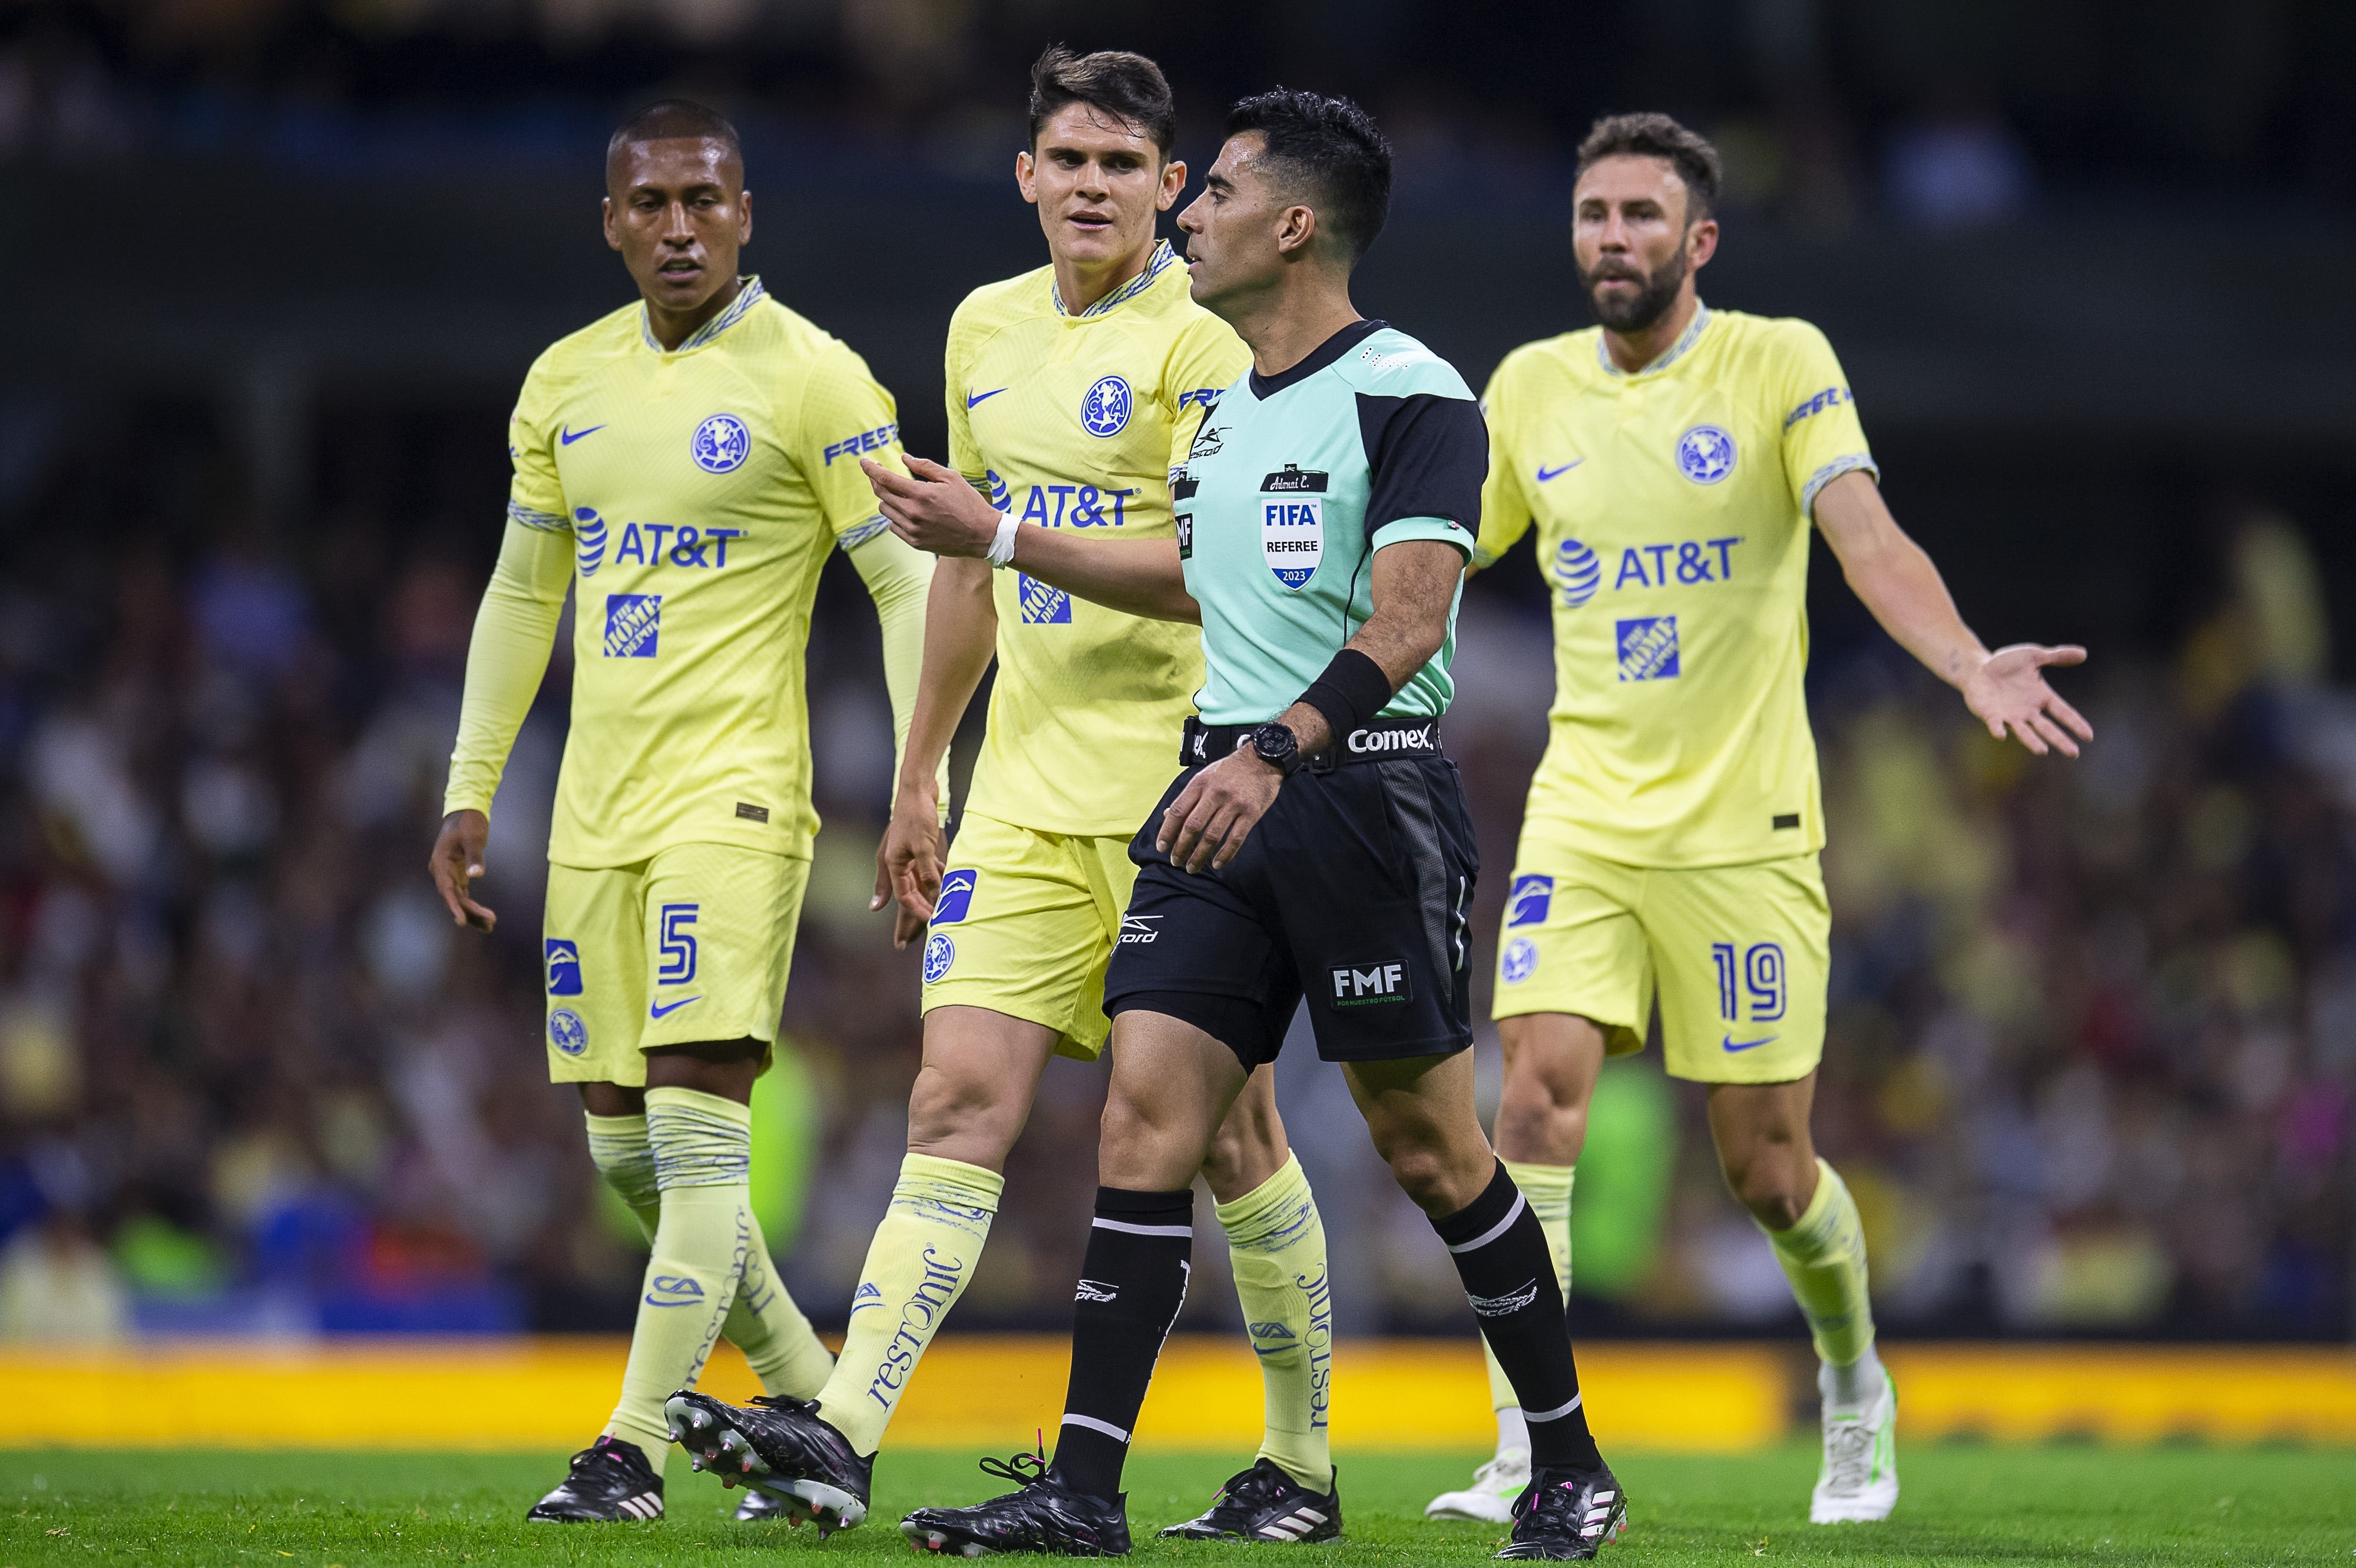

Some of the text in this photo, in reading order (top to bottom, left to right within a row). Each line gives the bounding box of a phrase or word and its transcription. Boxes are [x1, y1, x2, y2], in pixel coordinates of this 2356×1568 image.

[1022, 485, 1134, 528] AT&T
[1266, 505, 1316, 525] FIFA
[616, 522, 740, 568] AT&T
[1176, 518, 1190, 547] MF
[1267, 541, 1318, 553] REFEREE
[1283, 571, 1306, 581] 2023
[1615, 537, 1739, 591] AT&T
[604, 596, 660, 657] HOME
[658, 904, 699, 985] 5
[1333, 964, 1402, 997] FMF
[1712, 942, 1786, 1022] 19
